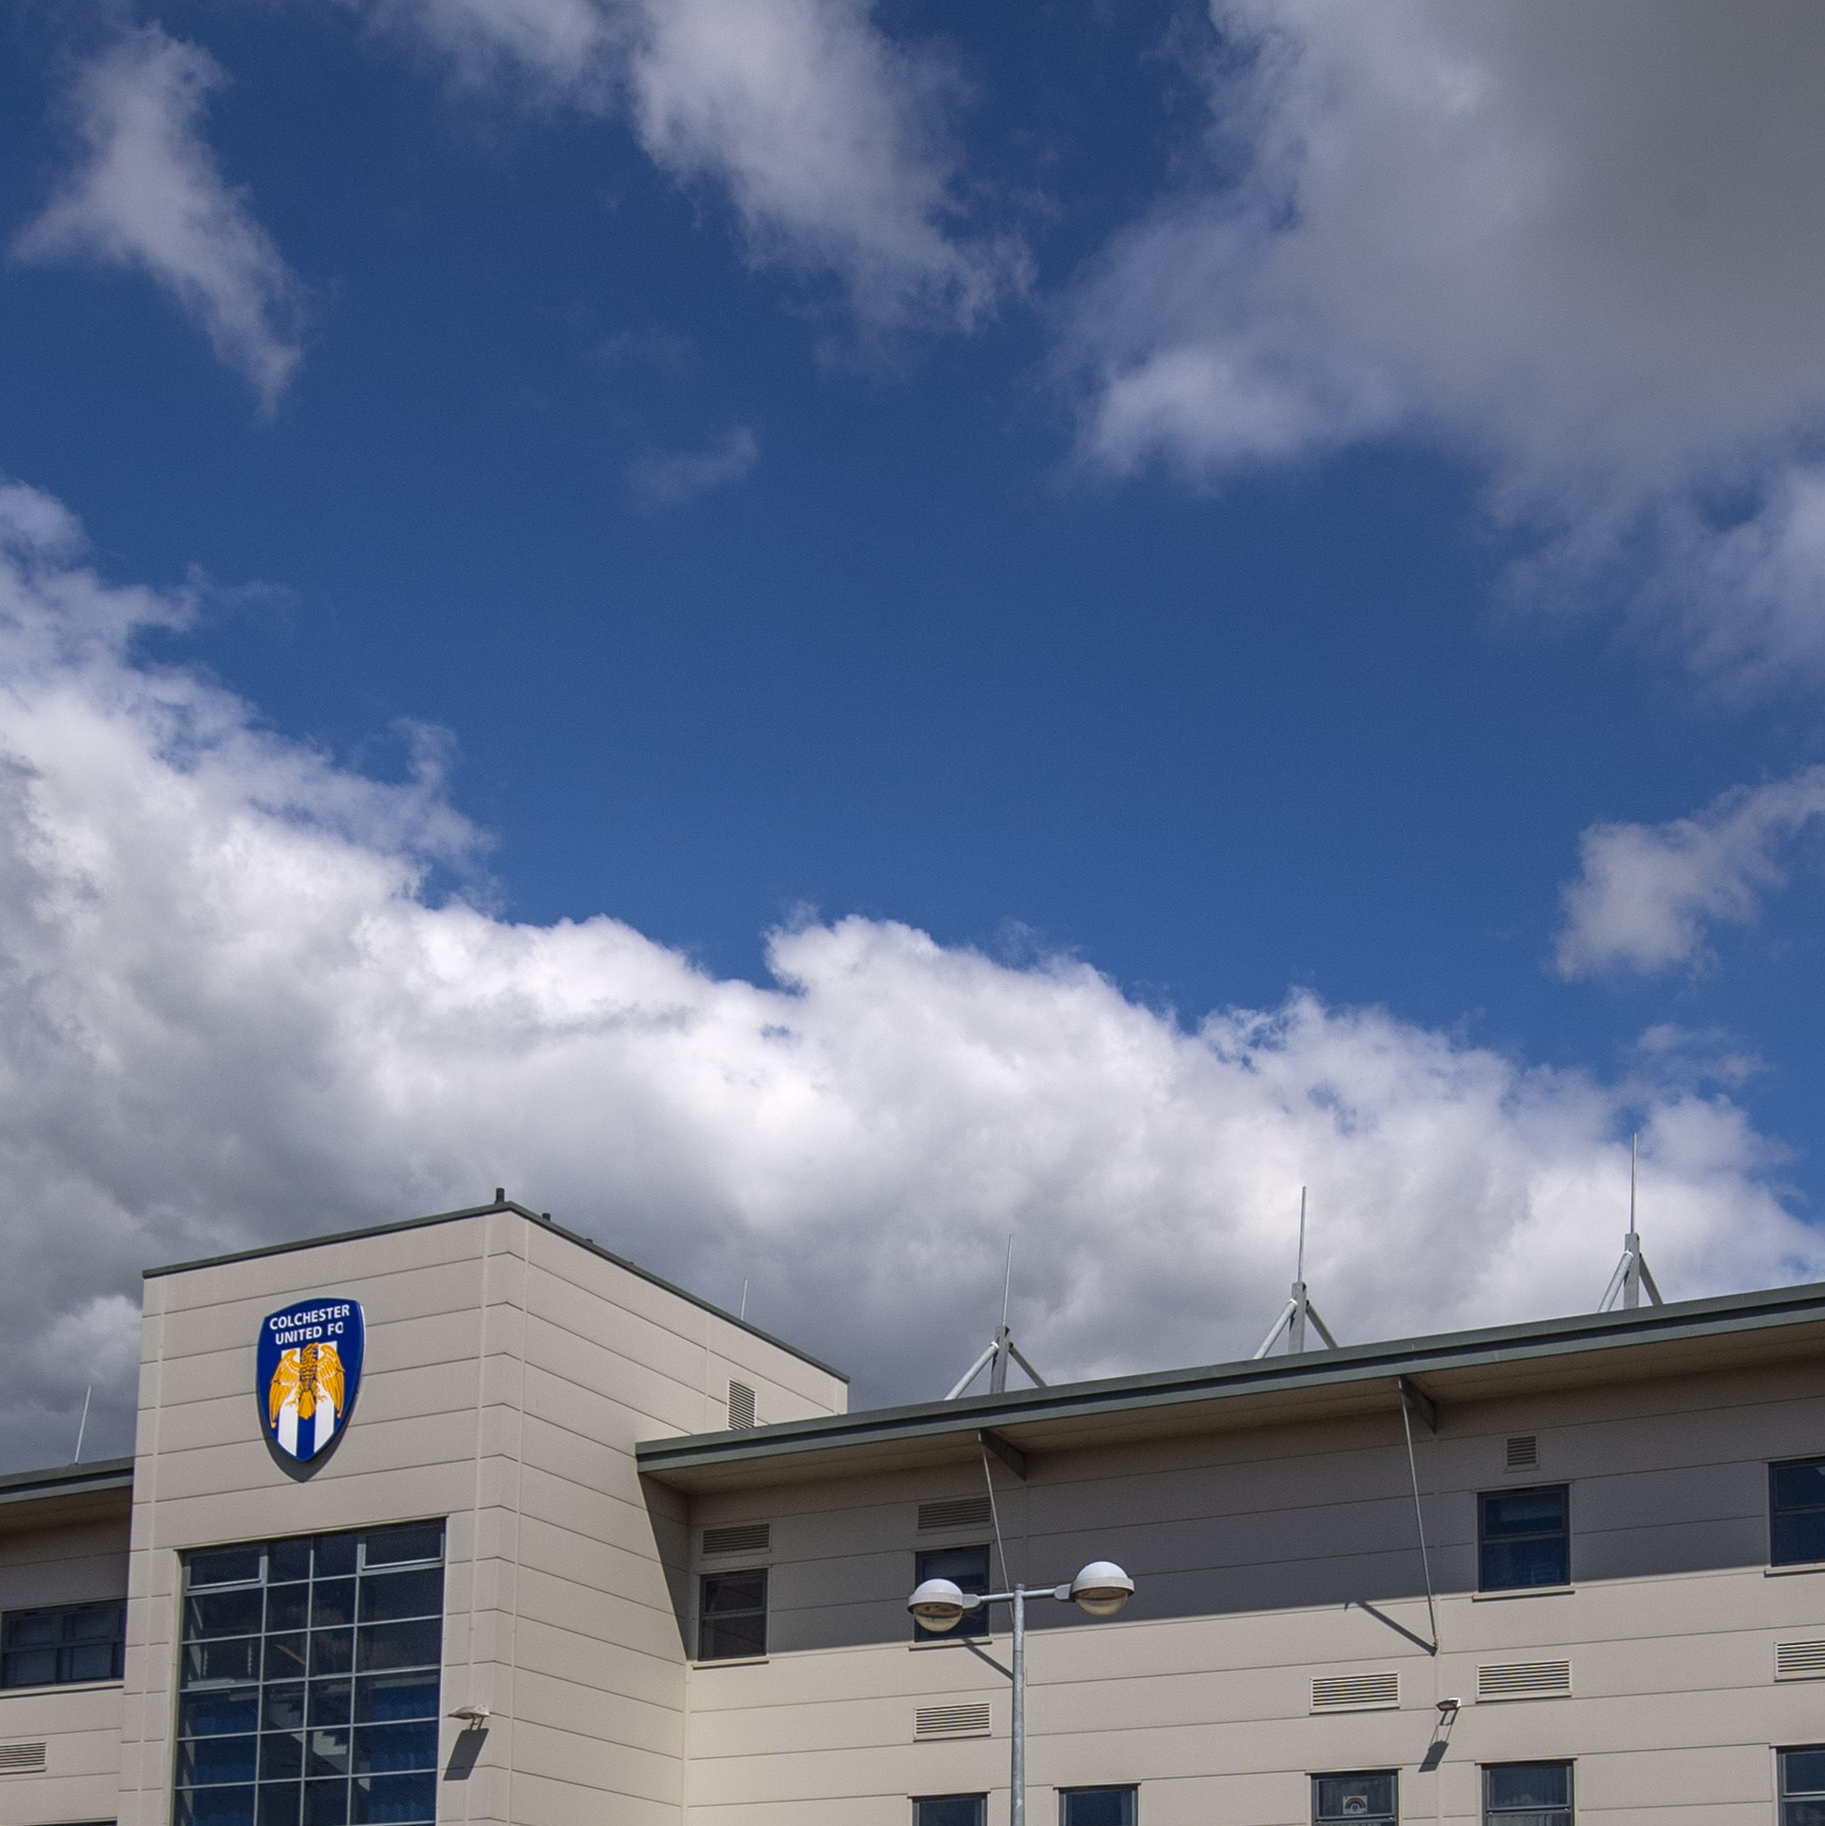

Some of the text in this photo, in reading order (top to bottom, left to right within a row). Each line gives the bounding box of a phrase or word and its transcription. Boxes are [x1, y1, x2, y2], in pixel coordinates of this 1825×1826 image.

[269, 1304, 350, 1330] COLCHESTER
[275, 1321, 344, 1346] UNITED FC
